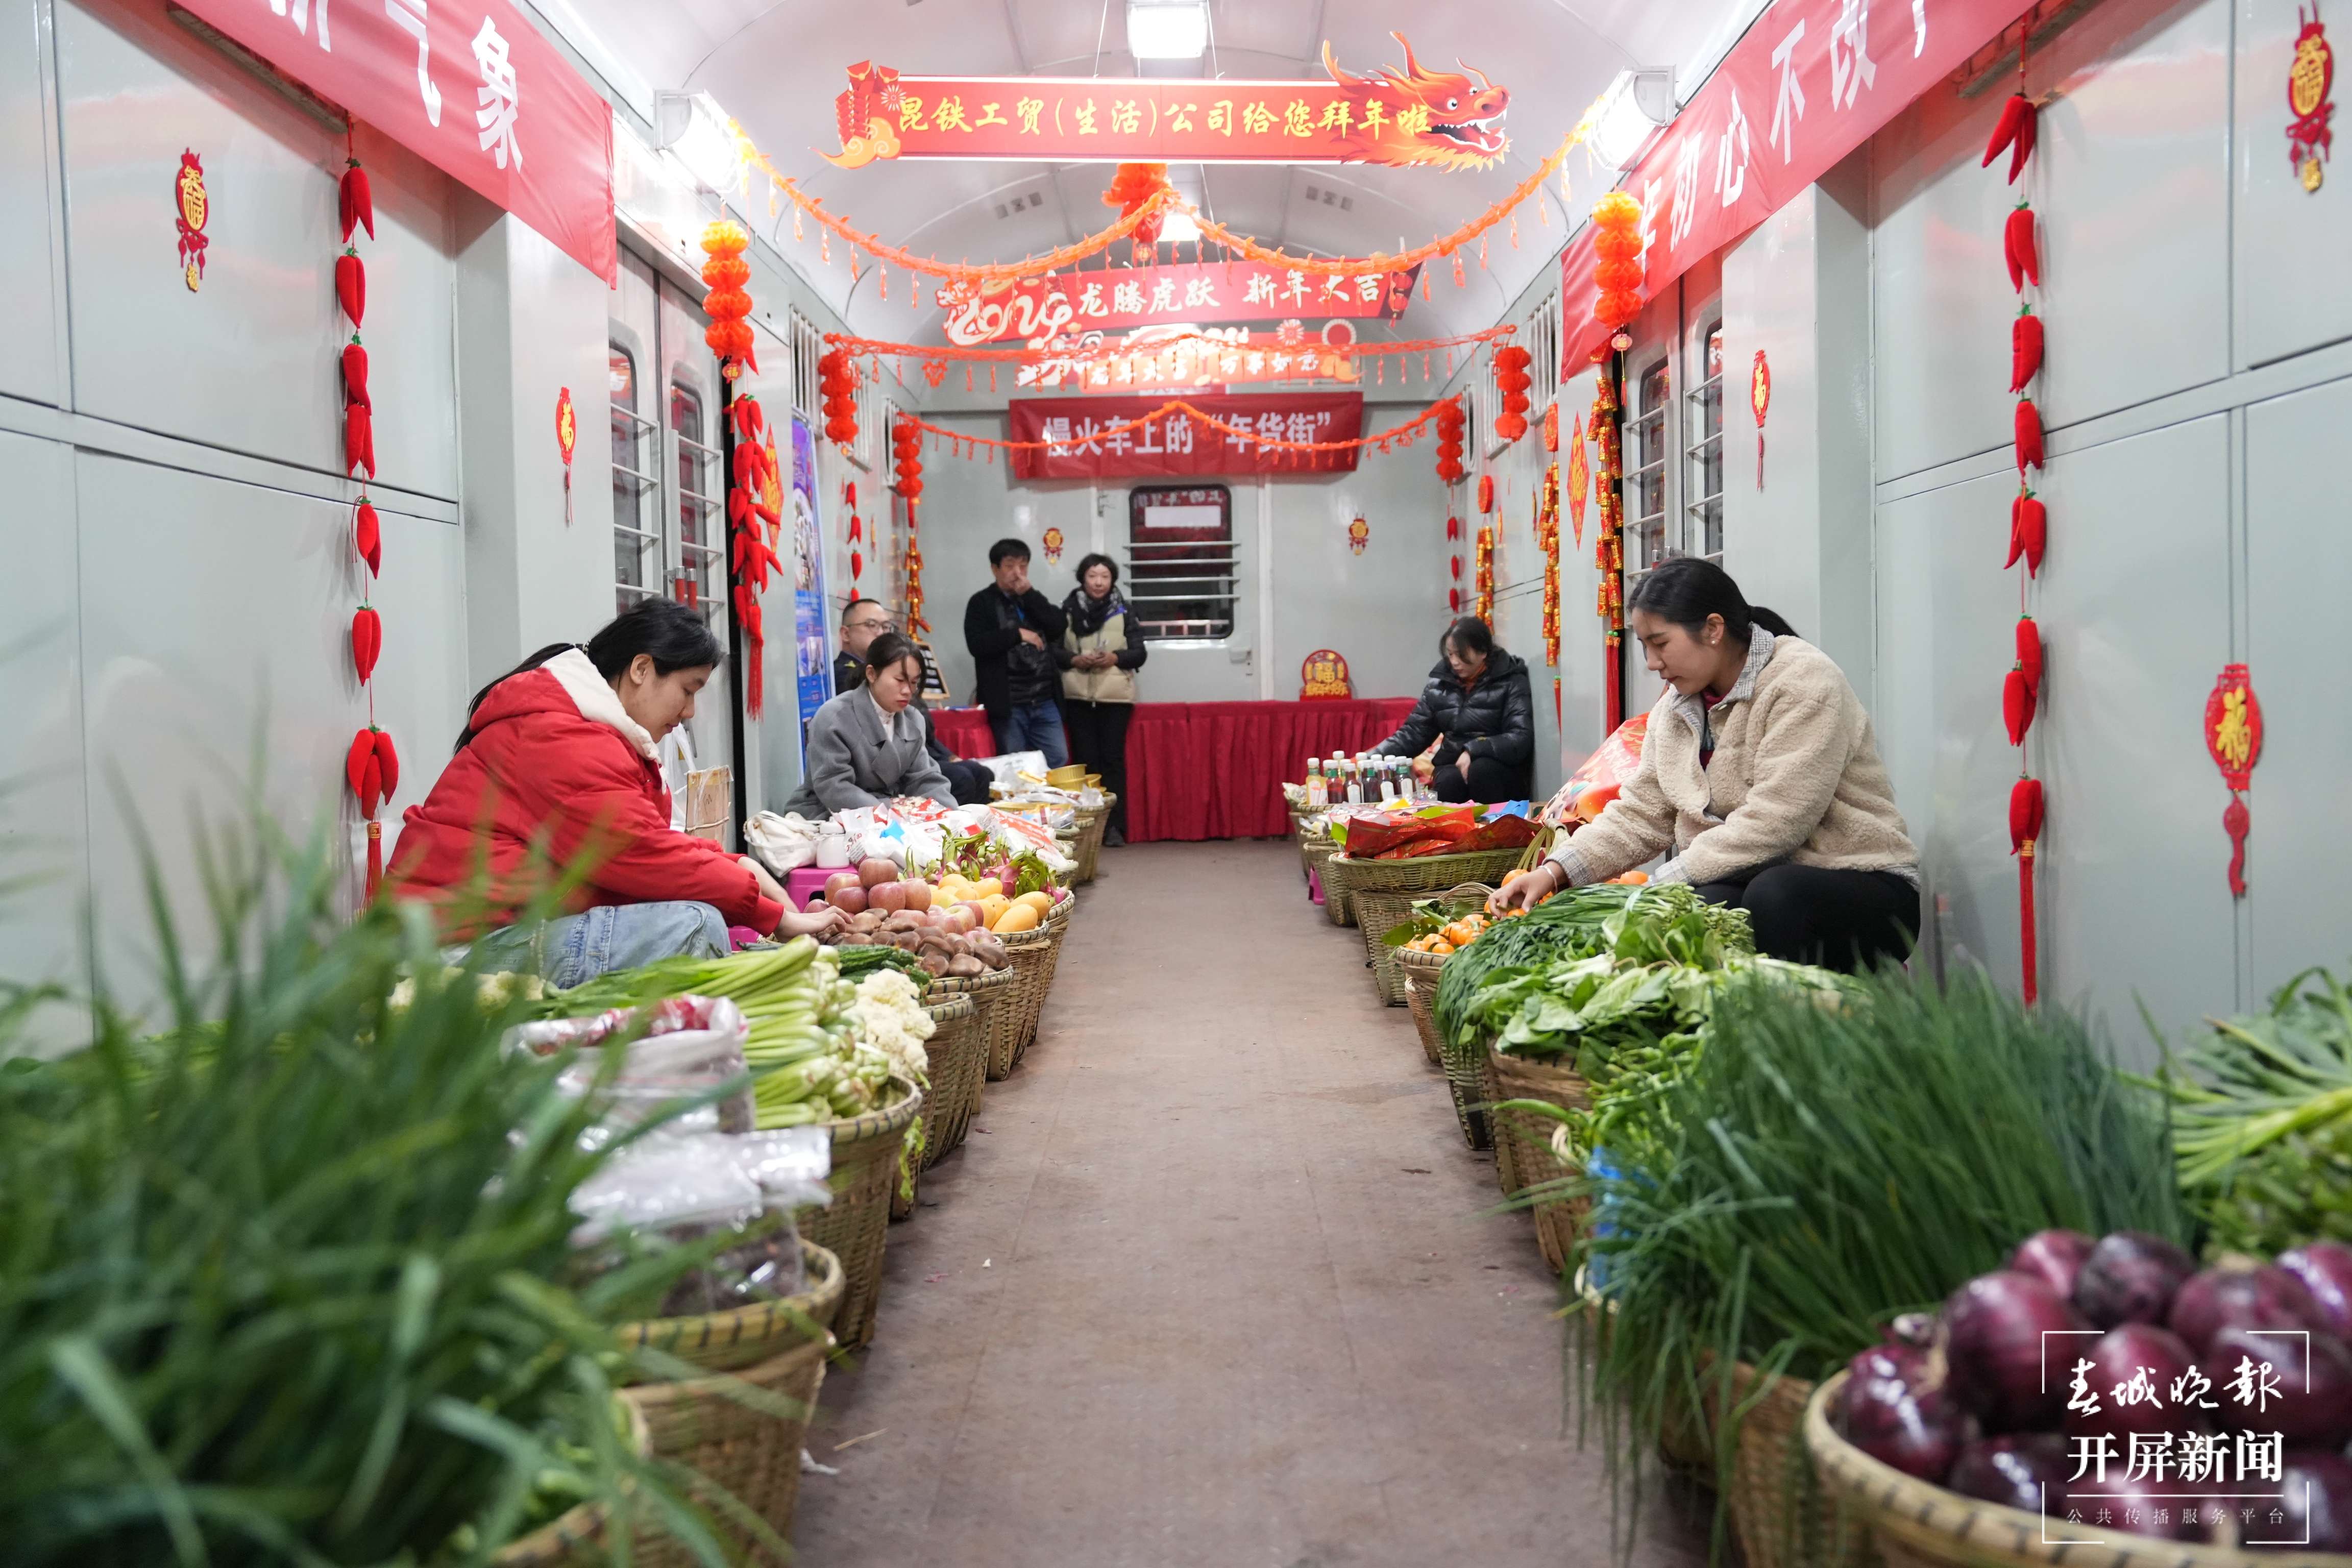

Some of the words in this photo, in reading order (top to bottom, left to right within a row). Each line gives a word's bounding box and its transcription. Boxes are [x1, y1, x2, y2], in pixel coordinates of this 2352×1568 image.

[268, 0, 524, 173] 气象
[899, 95, 1433, 141] 昆铁工贸（生活）公司给您拜年啦
[1592, 0, 1926, 316] 年初心不改
[1079, 276, 1220, 317] 龙腾虎跃
[1242, 269, 1385, 309] 新年大吉
[1042, 412, 1331, 457] 慢火车上的“年货街”
